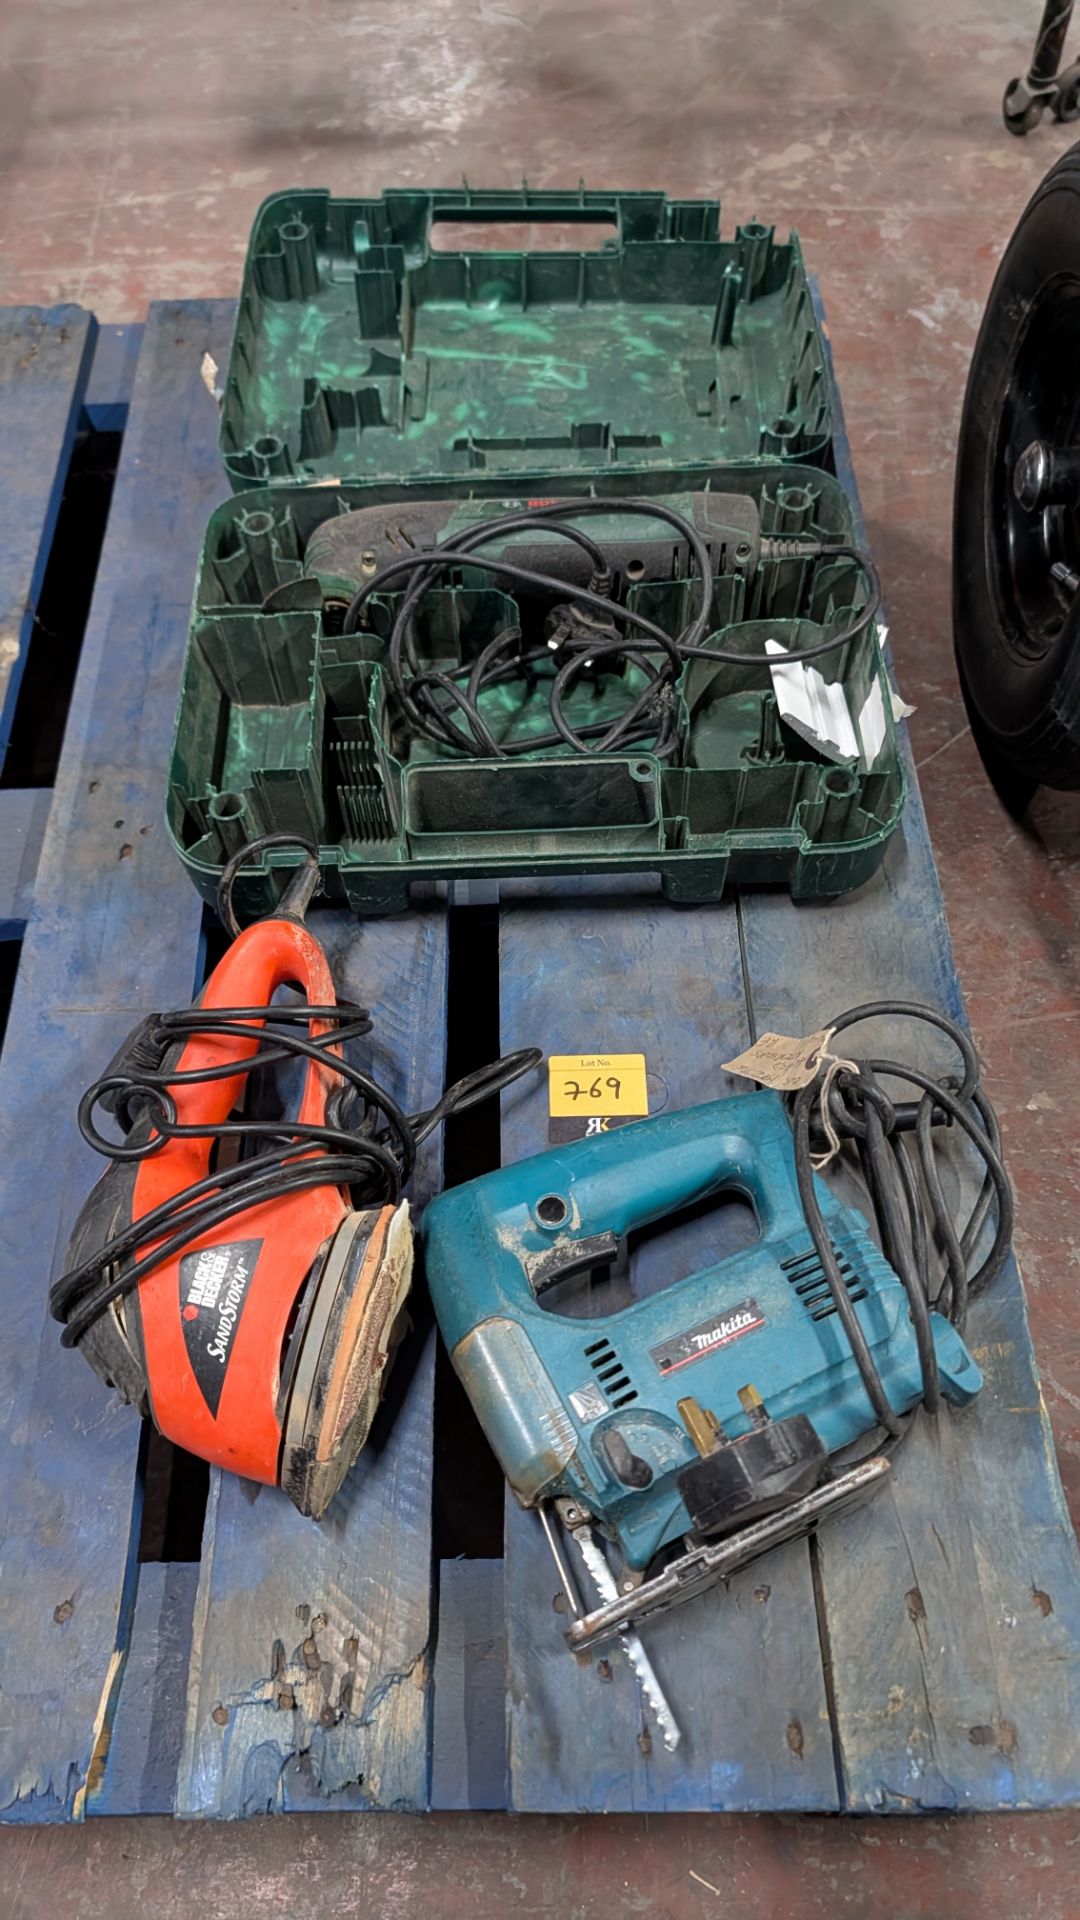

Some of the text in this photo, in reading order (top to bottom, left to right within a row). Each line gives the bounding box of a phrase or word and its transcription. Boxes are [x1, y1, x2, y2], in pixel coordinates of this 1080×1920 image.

[581, 1058, 612, 1067] Lot No.
[564, 1076, 621, 1100] 769
